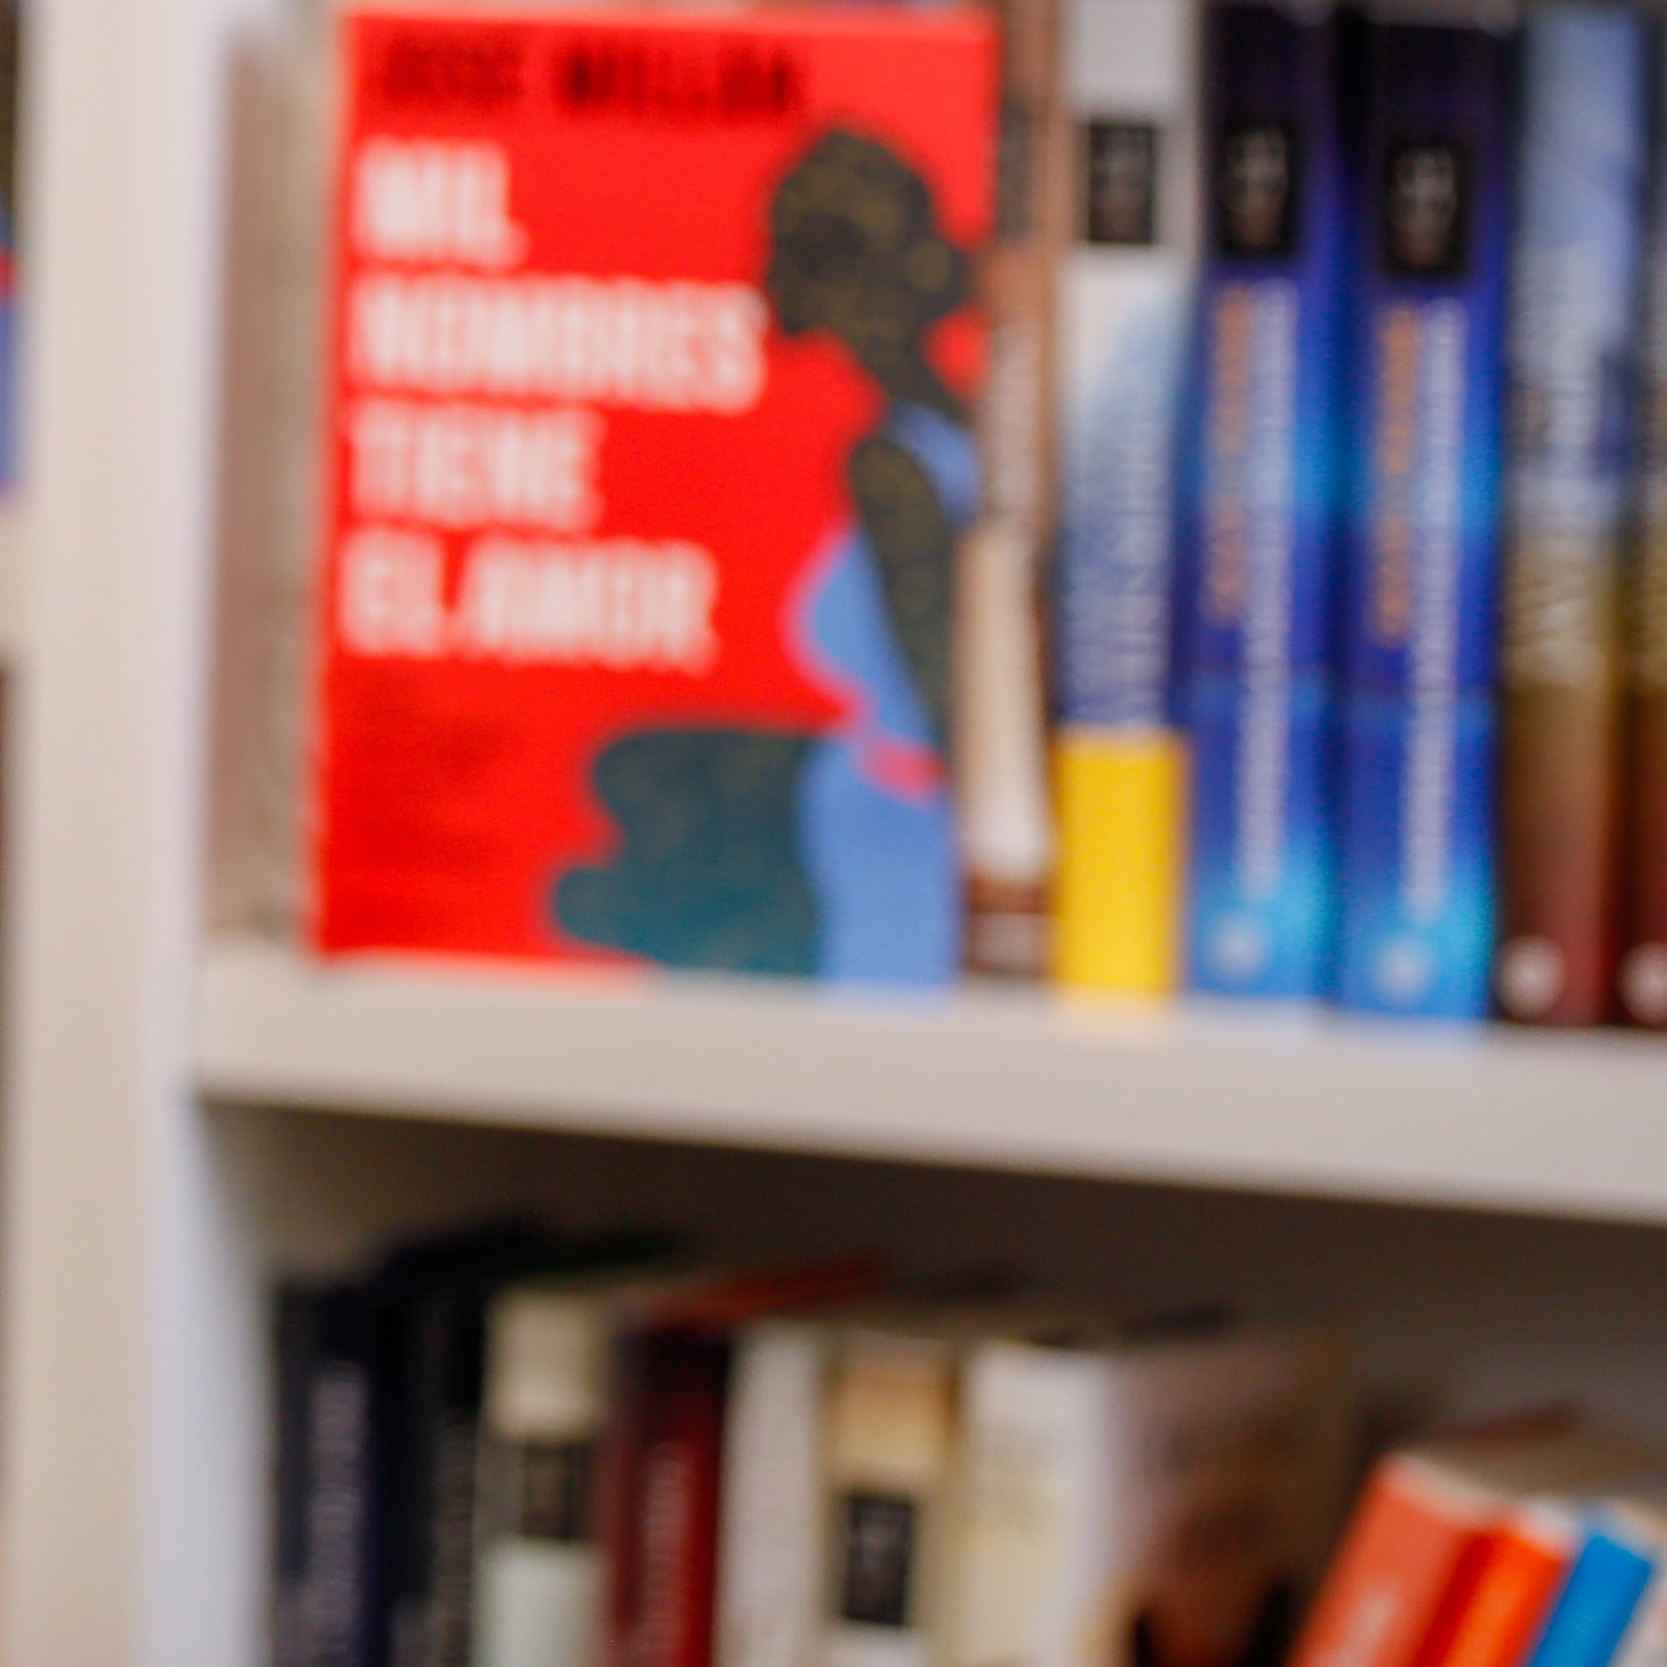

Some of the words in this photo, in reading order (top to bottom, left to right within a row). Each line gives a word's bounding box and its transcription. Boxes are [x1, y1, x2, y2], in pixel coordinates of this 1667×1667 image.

[353, 136, 527, 270] MIL
[349, 271, 769, 416] NOMBRES
[347, 400, 601, 534] TIENE
[335, 524, 451, 659] EL
[457, 536, 719, 676] AMOR
